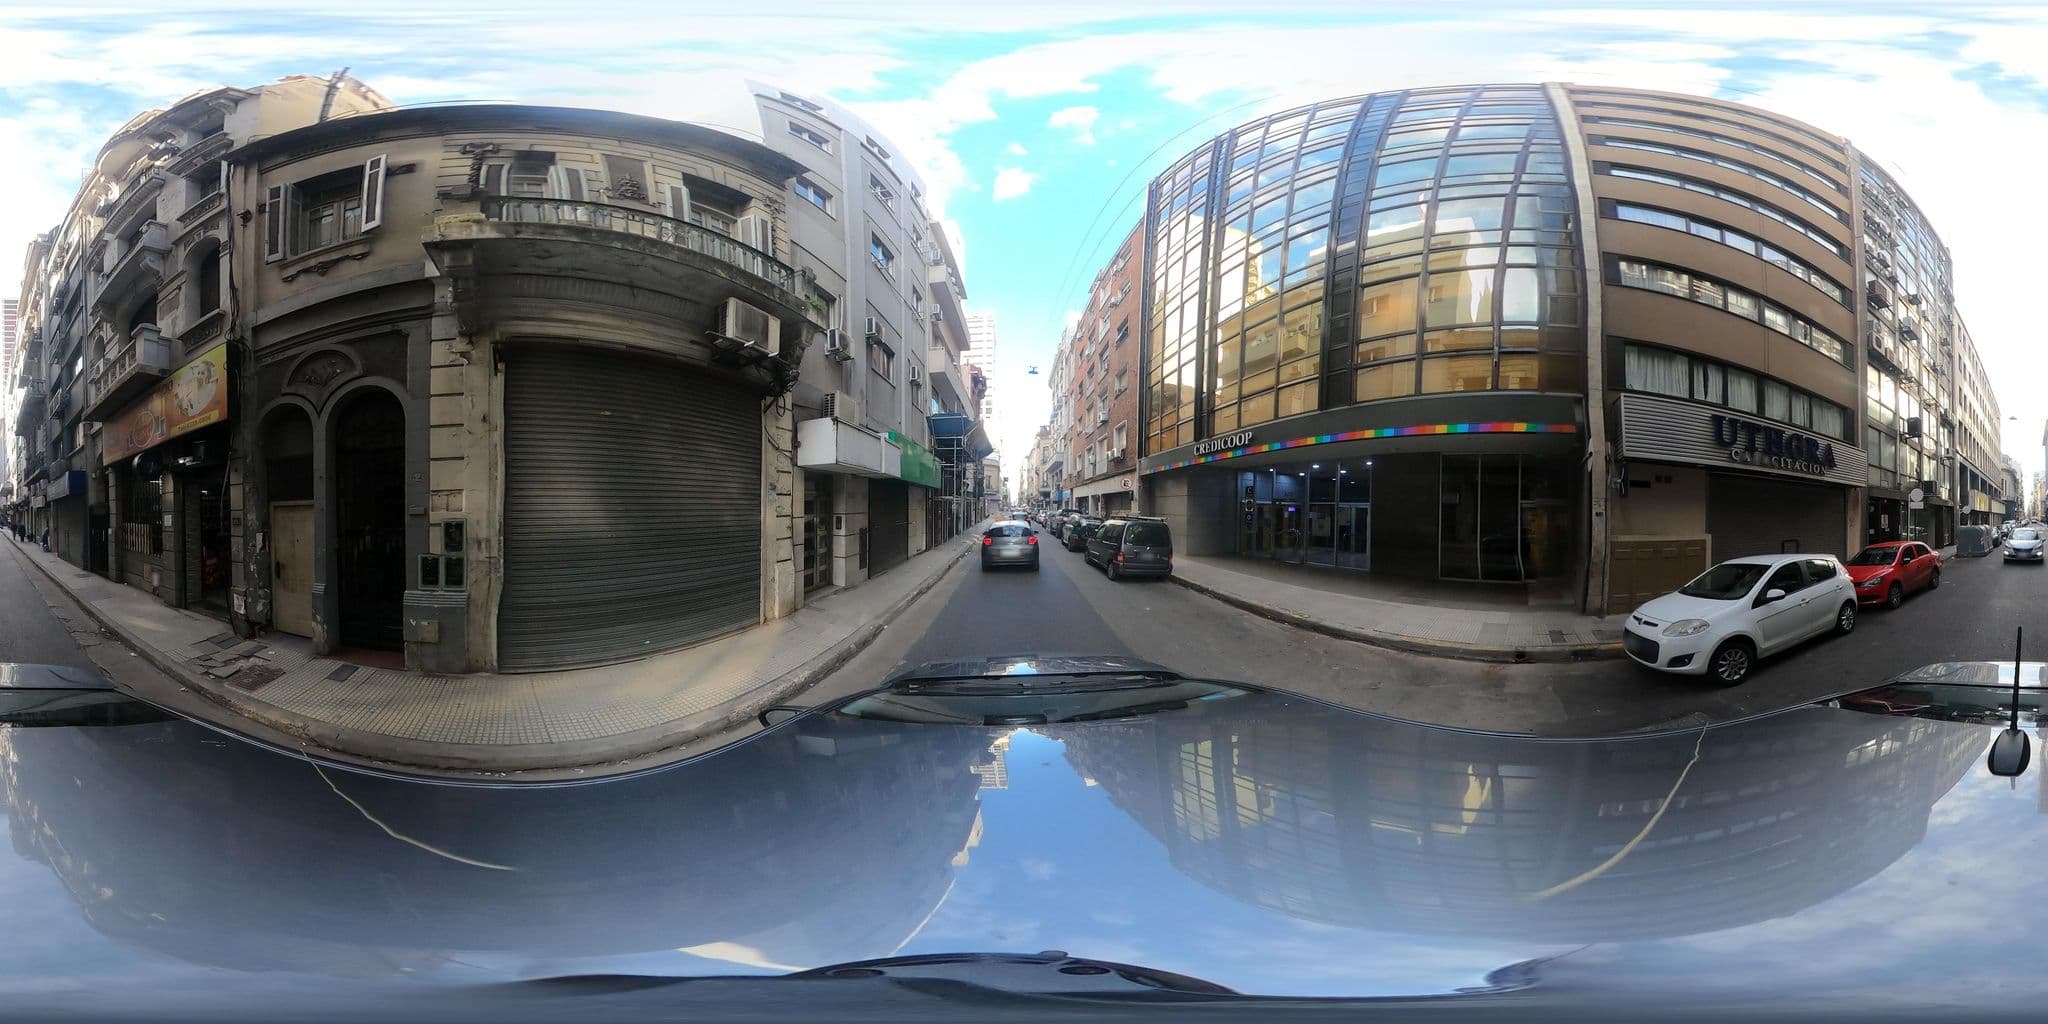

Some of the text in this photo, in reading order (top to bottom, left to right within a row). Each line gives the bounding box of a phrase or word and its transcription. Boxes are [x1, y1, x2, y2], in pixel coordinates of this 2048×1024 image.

[1193, 432, 1253, 456] CREDICOOP
[1711, 414, 1837, 468] UTHGRA
[1731, 448, 1827, 475] CACITACION
